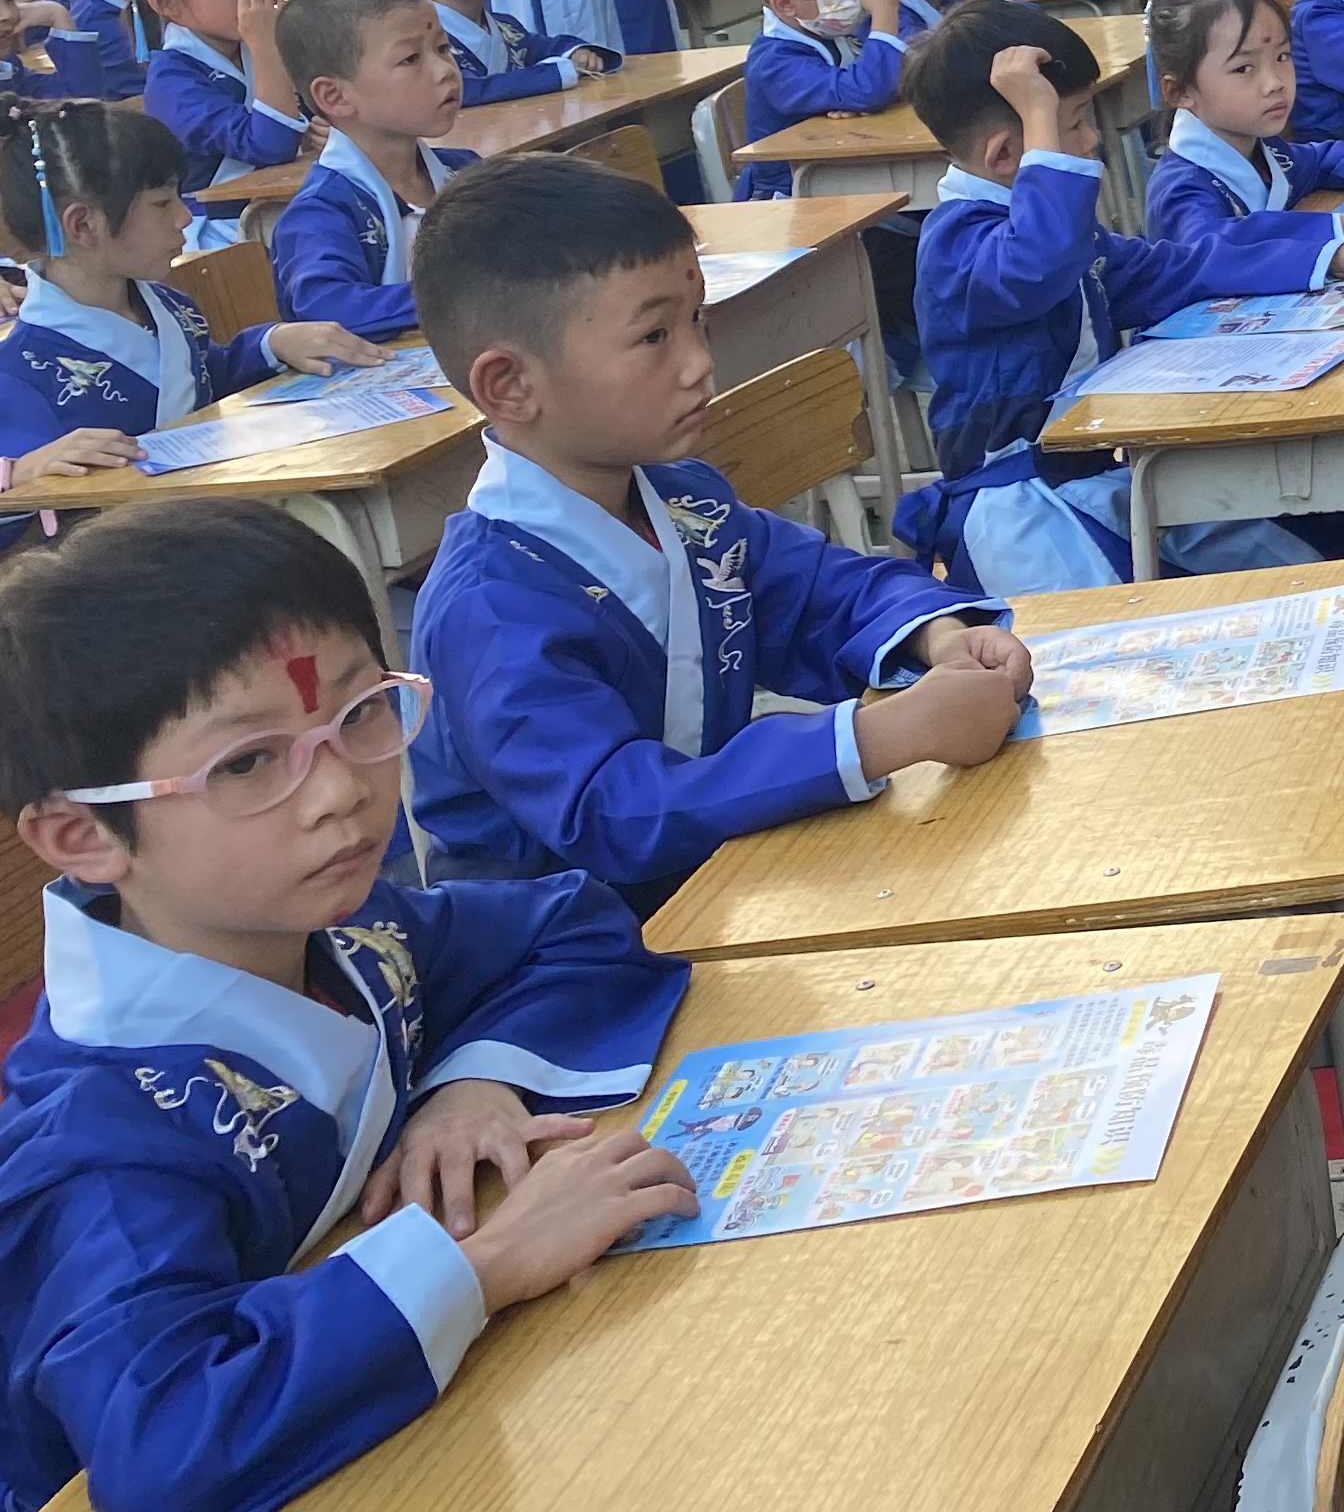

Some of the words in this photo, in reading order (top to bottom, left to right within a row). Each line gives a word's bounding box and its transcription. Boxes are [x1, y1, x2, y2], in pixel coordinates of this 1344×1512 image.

[1100, 1041, 1166, 1145] 毒品预防知识
